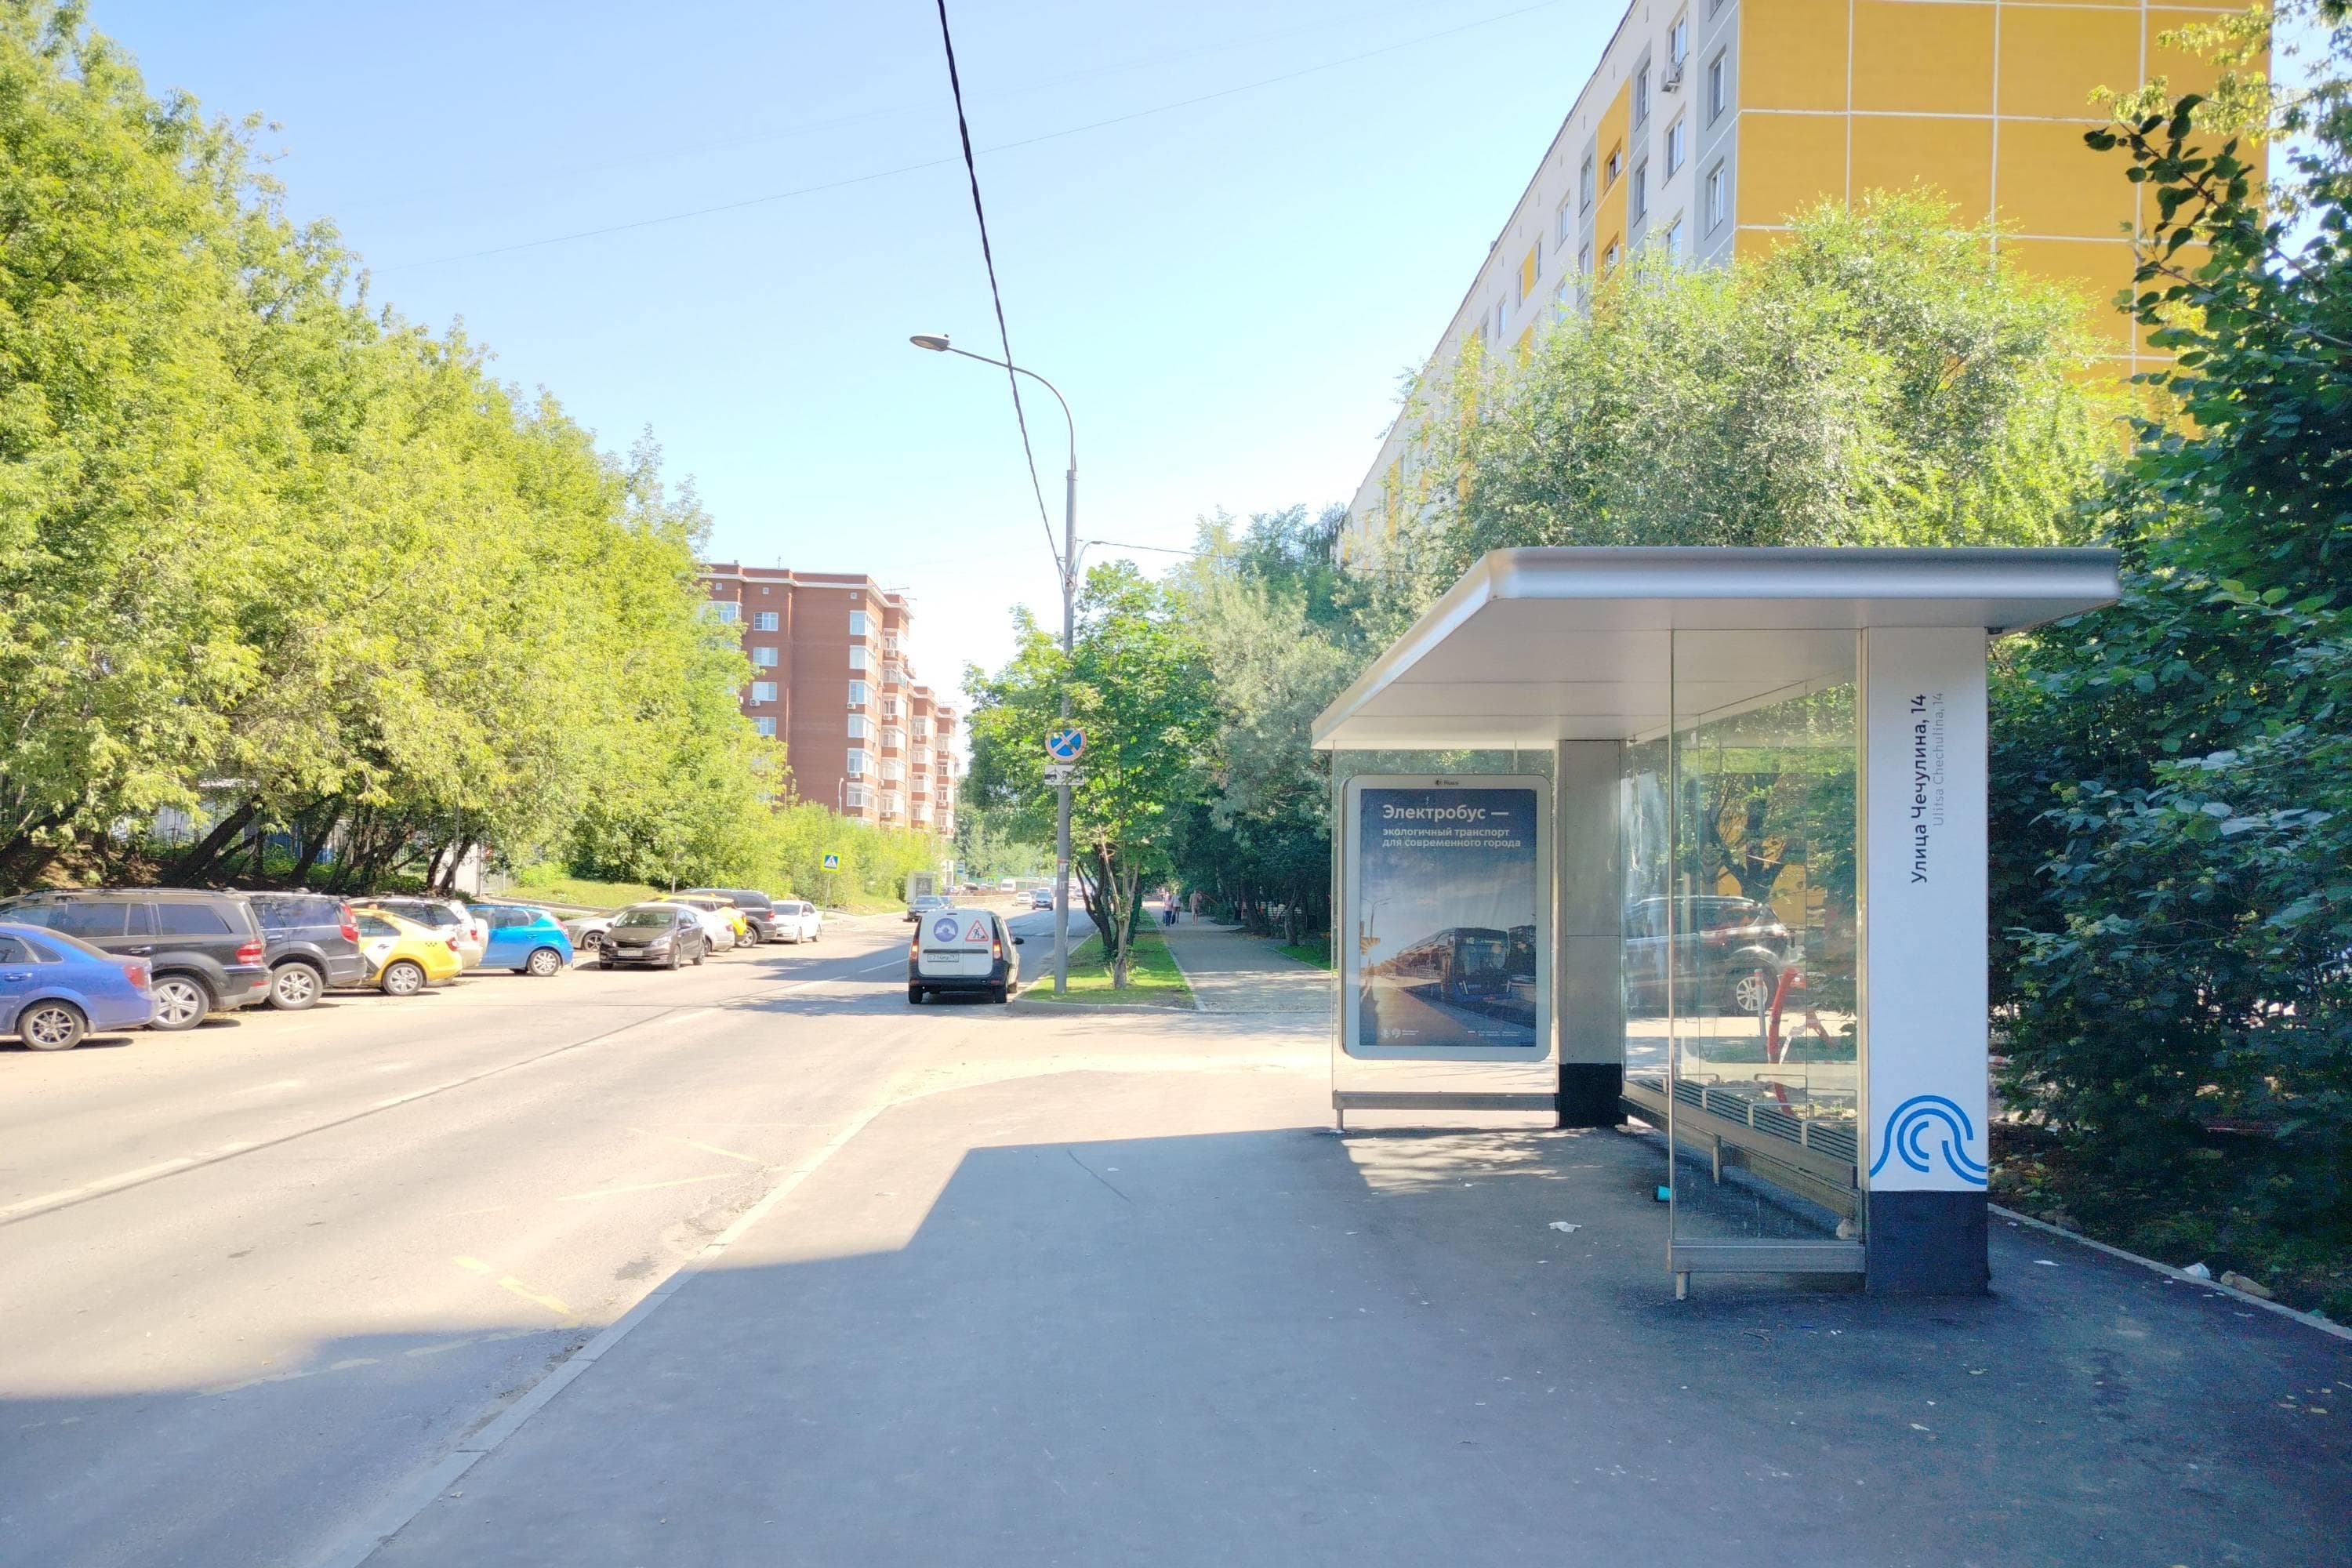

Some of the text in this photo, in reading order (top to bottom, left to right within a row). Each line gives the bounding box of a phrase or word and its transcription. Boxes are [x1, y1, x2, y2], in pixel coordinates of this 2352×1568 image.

[1933, 692, 1945, 826] Ulitsa Chechulina, 14
[1911, 694, 1930, 884] Улица Чечулина, 14
[1382, 804, 1486, 822] Электробус
[1382, 827, 1510, 838] экологичный транспорт
[1382, 839, 1521, 848] для современного города
